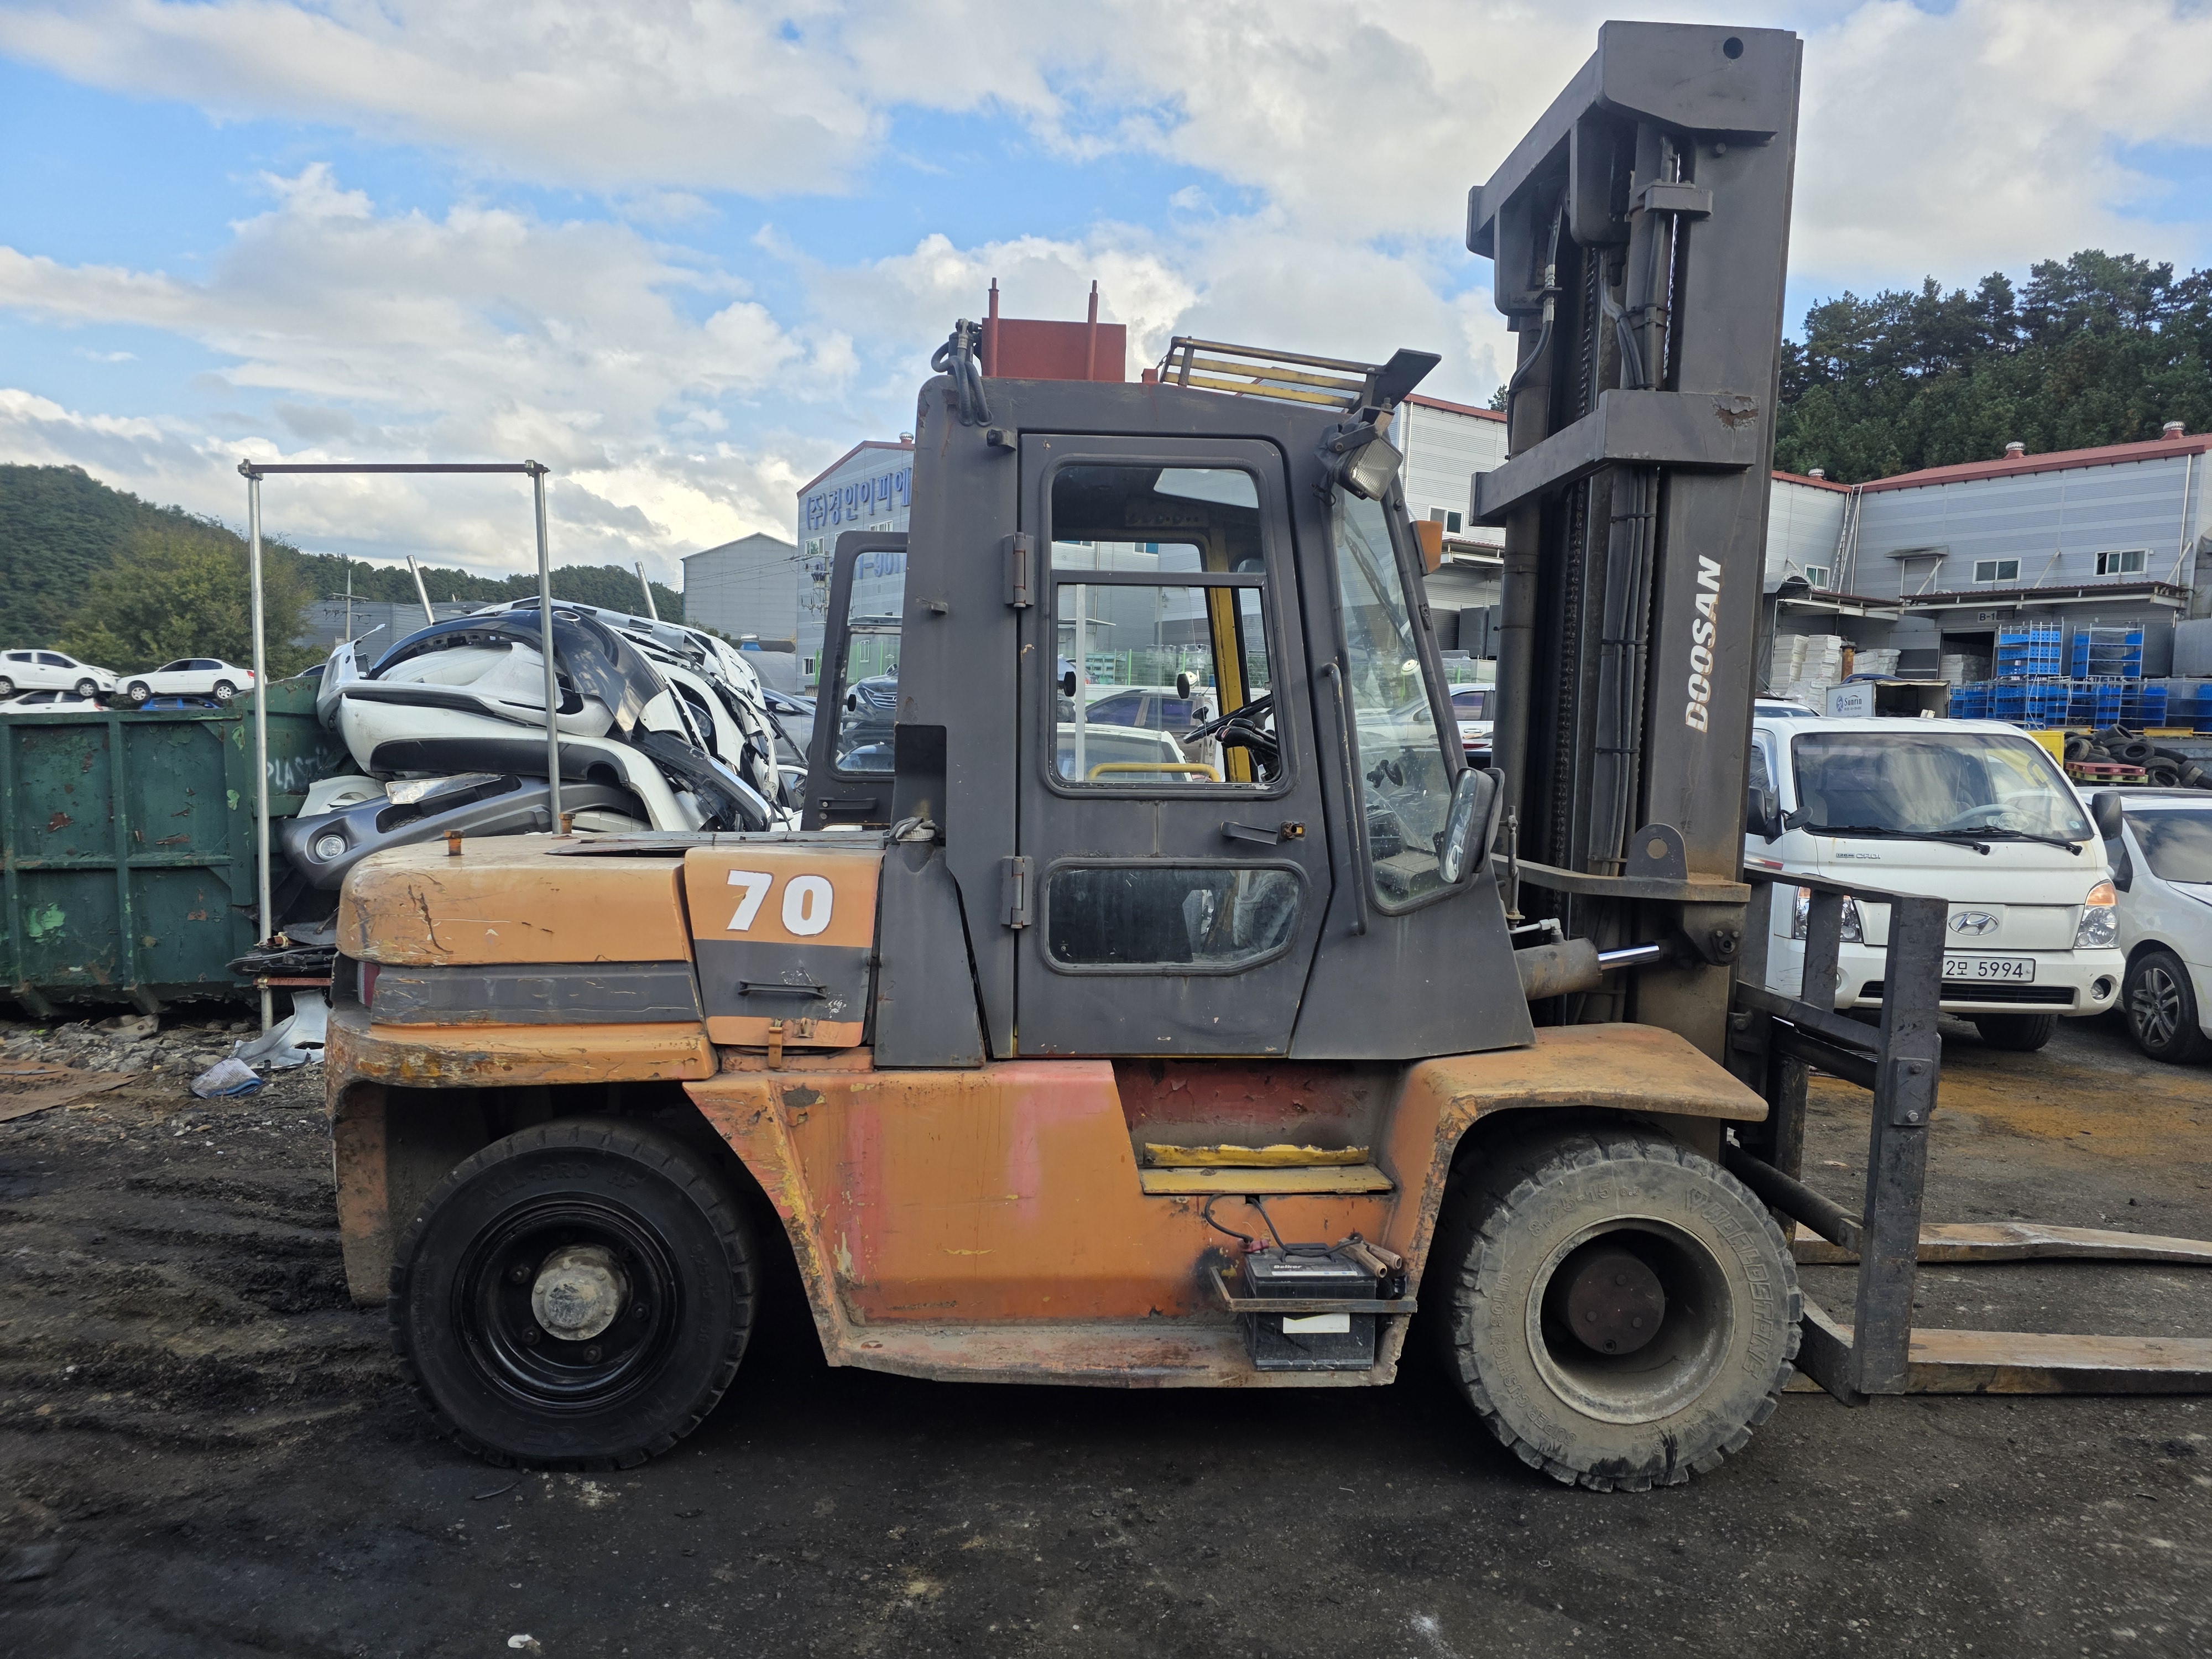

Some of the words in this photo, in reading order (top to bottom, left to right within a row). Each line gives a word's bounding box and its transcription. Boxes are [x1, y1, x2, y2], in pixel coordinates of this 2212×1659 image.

[1686, 554, 1721, 733] DOOSAN
[1844, 696, 1862, 706] Sunrin
[726, 869, 834, 936] 70
[1978, 961, 2023, 978] 5994
[1527, 1181, 1613, 1237] 8.25-15
[1526, 1404, 1577, 1447] SUPER
